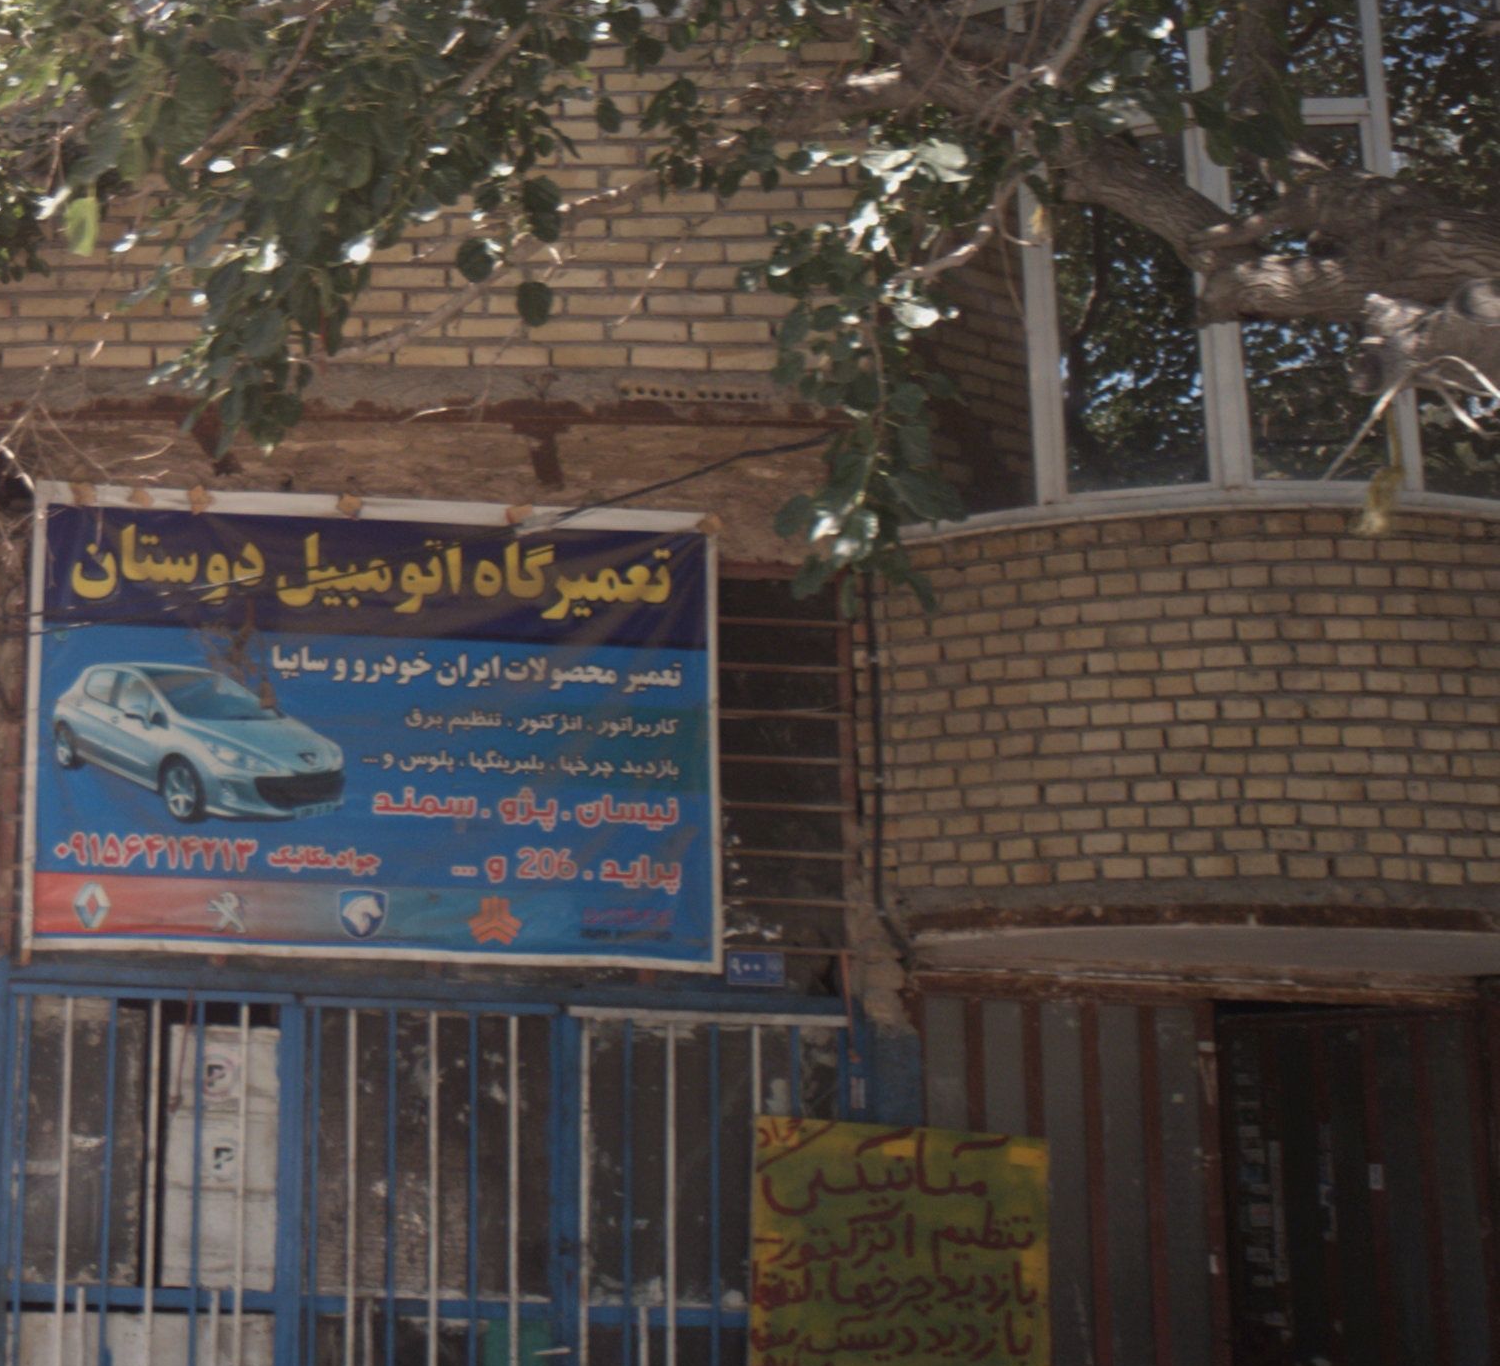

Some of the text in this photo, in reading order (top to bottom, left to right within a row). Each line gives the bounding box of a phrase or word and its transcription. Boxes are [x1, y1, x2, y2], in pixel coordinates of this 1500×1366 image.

[71, 523, 672, 620] تعمیرگاه اتومبیل دوستان
[270, 644, 683, 693] تعمیر محصولات ایران خودرو و سایپا
[405, 706, 444, 730] برق
[448, 708, 501, 734] تنظیم
[619, 758, 680, 781] بازدید
[372, 786, 478, 819] سمند
[53, 831, 259, 872] ۰۹۱۵۶۴۱۴۲۱۳
[266, 844, 382, 876] جواد مکانیک
[515, 846, 579, 880] 206
[930, 1200, 1036, 1274] تنظیم
[936, 1260, 1039, 1319] بازدید
